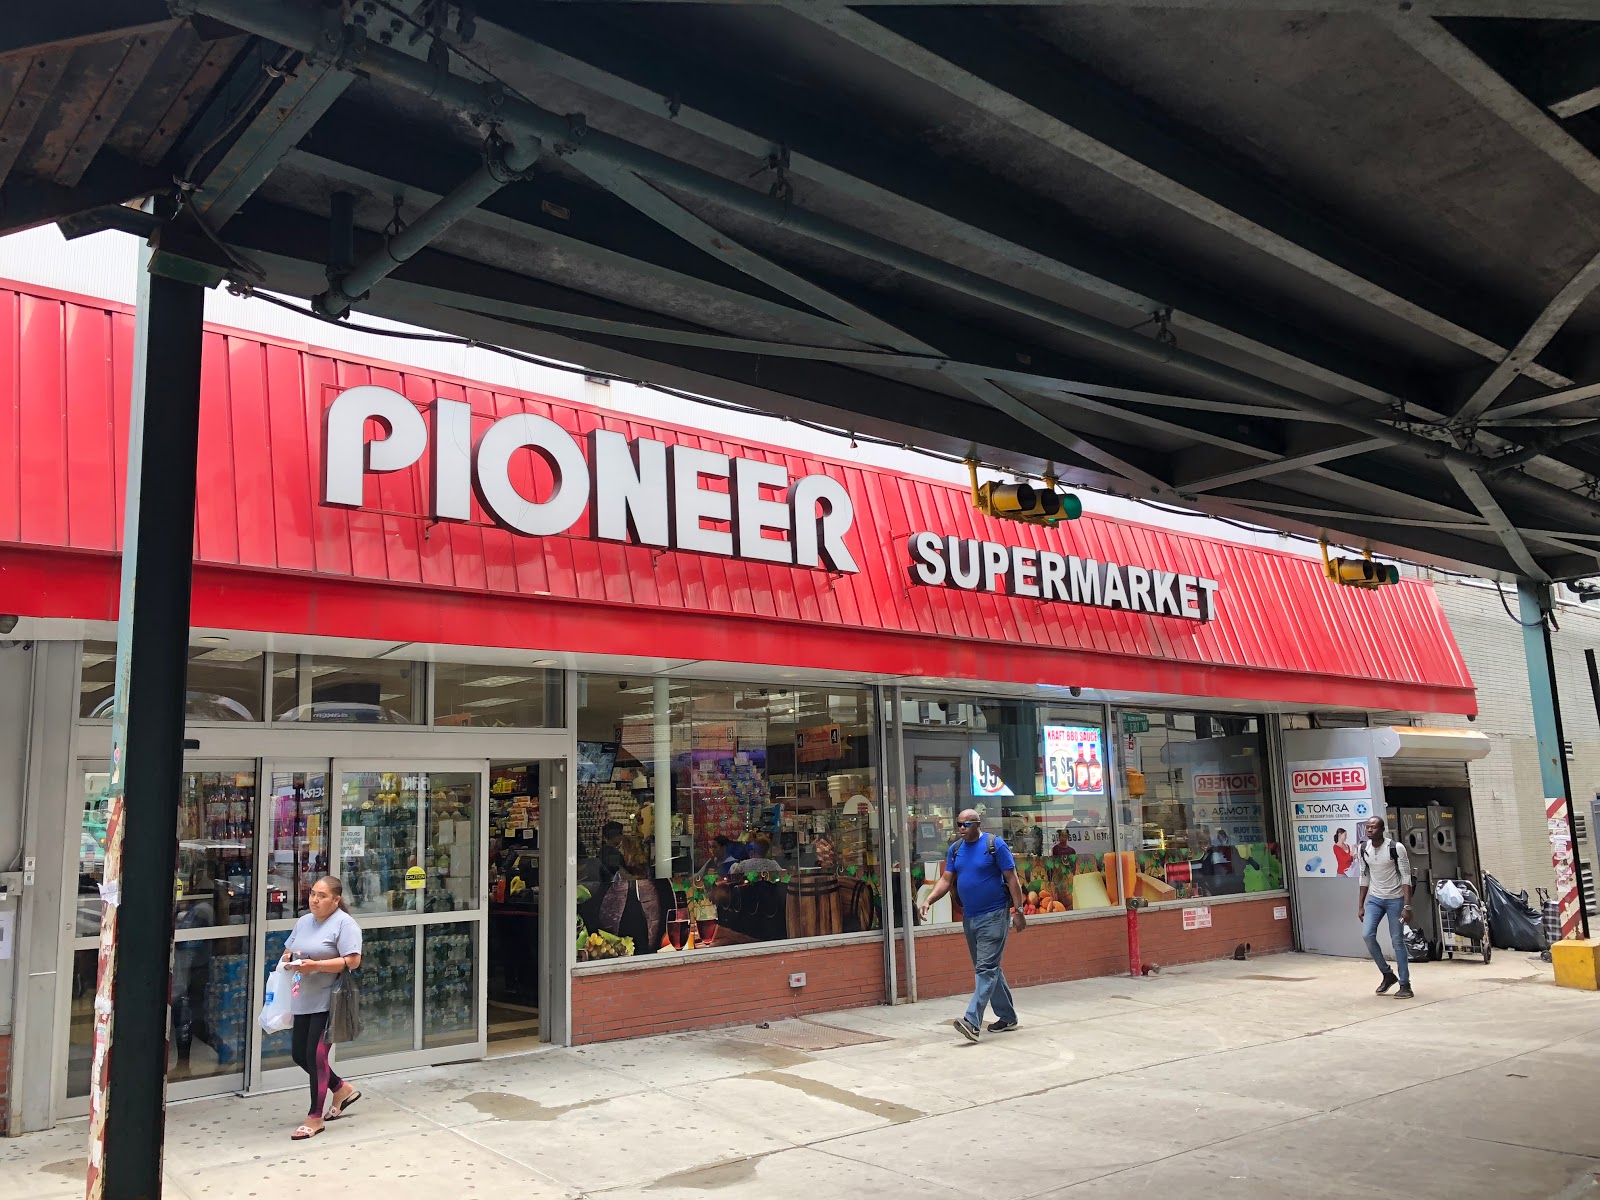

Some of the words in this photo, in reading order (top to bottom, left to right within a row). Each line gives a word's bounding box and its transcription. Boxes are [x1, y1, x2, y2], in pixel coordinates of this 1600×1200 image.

[322, 385, 860, 574] PIONEER
[911, 531, 1219, 621] SUPERMARKET
[1047, 730, 1065, 741] KRAFT
[1067, 730, 1078, 742] BBQ
[1079, 731, 1098, 742] SAUCE
[1294, 770, 1362, 786] PIONEER
[1306, 803, 1350, 813] TOMRA
[1298, 825, 1310, 834] GET
[1310, 825, 1328, 833] YOUR
[1298, 834, 1324, 843] NICKELS
[1299, 843, 1319, 852] BACK!
